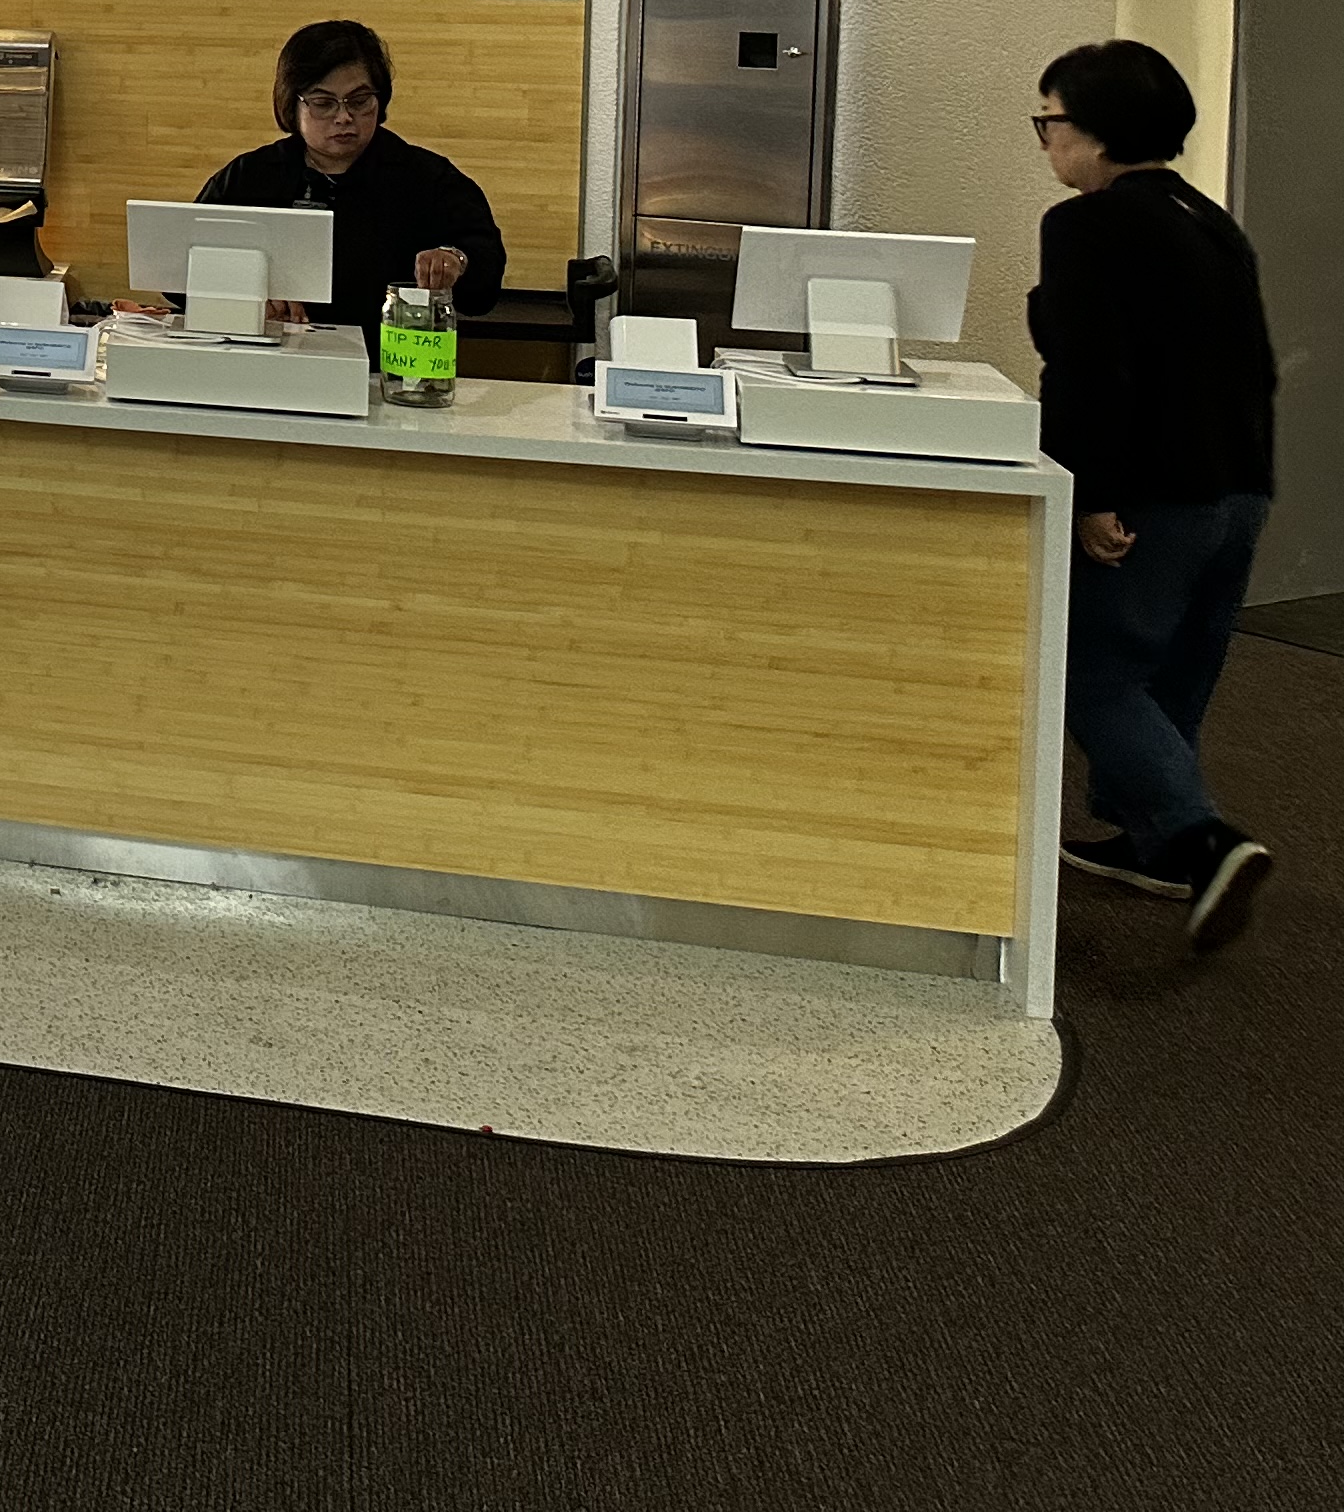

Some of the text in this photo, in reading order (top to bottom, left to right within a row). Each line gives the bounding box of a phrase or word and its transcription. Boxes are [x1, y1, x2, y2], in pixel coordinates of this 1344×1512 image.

[386, 330, 441, 349] TIP JAR
[382, 349, 449, 372] THANK YOU
